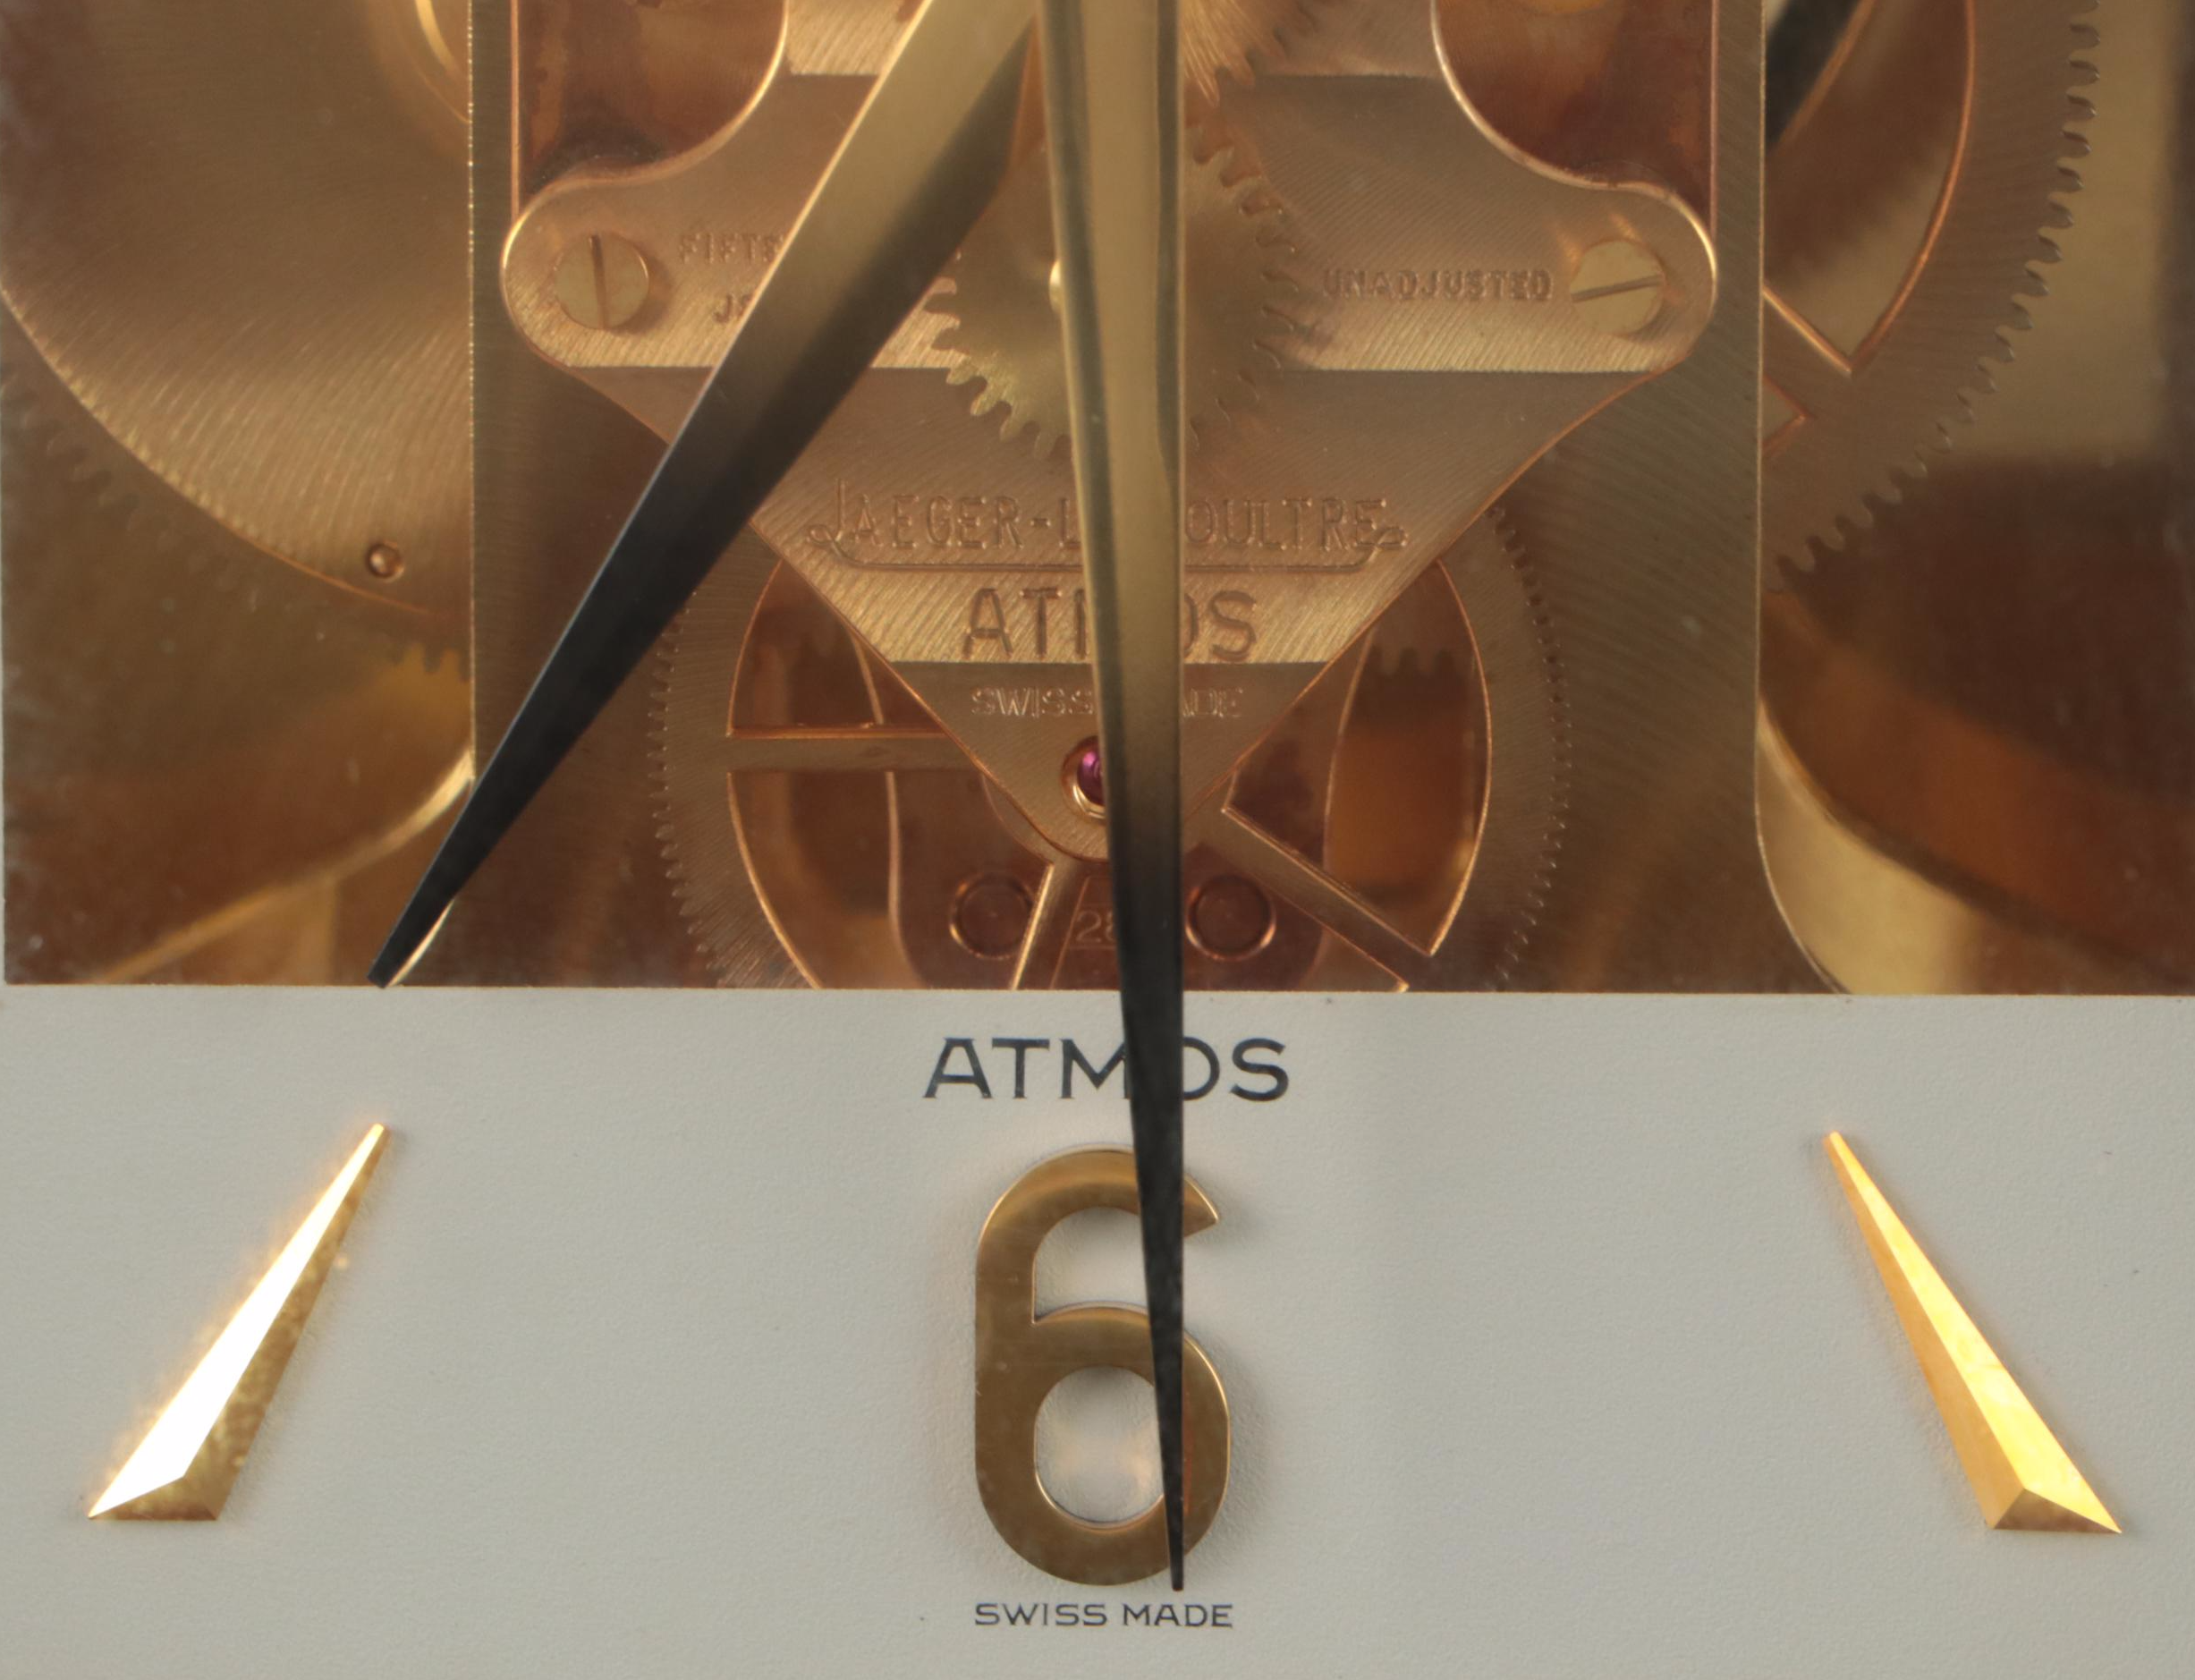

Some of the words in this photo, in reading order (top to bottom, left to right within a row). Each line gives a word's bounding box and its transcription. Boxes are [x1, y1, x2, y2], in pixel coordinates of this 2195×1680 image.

[680, 233, 785, 264] FIFTE
[1322, 268, 1554, 301] UNADJUSTED
[807, 478, 1408, 555] JAEGER-LOULTRE
[970, 686, 1094, 717] SWISS
[975, 1143, 1231, 1586] 6
[974, 1602, 1108, 1627] SWISS
[1122, 1603, 1233, 1628] MADE
